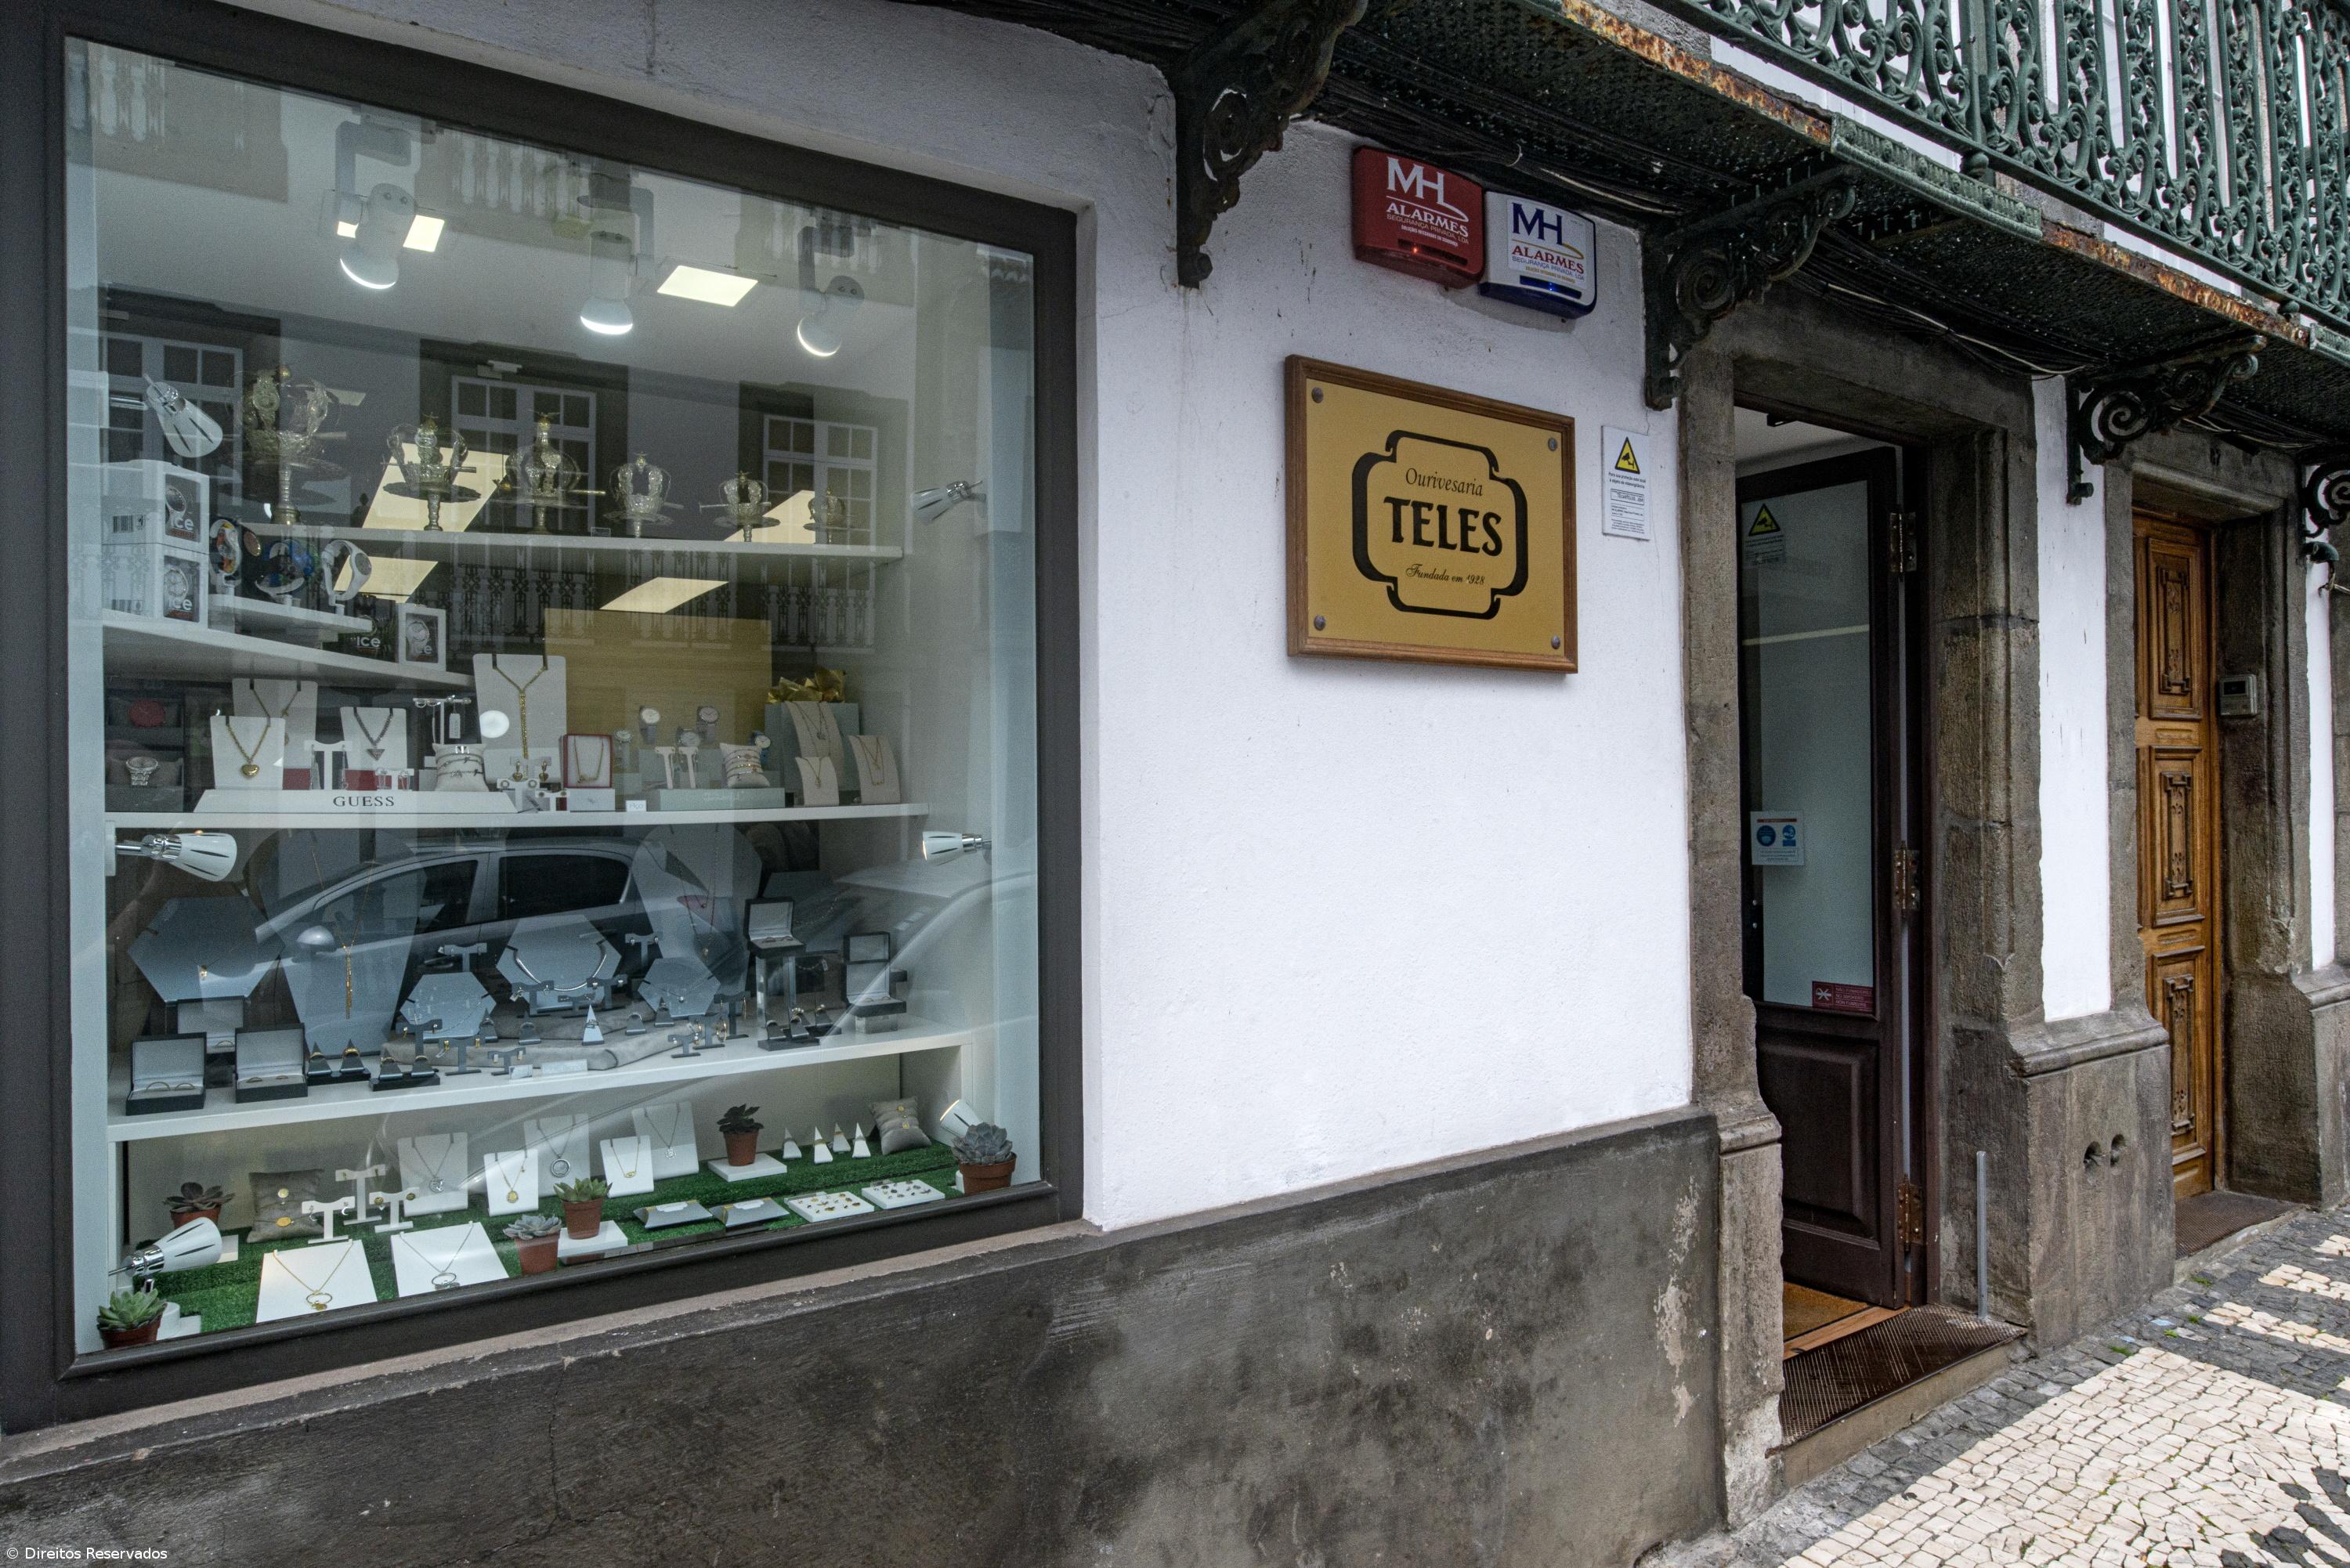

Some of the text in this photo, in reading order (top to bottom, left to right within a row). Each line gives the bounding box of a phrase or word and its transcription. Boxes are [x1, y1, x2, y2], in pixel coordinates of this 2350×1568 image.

[1386, 157, 1444, 204] MH
[1386, 202, 1469, 237] ALARMES
[1386, 214, 1429, 229] SEGURANÇA
[1512, 202, 1563, 245] MH
[1512, 245, 1584, 274] ALARMES
[1512, 255, 1549, 269] SEGURANÇA
[1405, 468, 1483, 496] Ourivesaria
[1383, 497, 1502, 556] TELES
[1405, 563, 1449, 581] Fundada
[1466, 575, 1485, 585] 1928
[333, 796, 395, 807] GUESS
